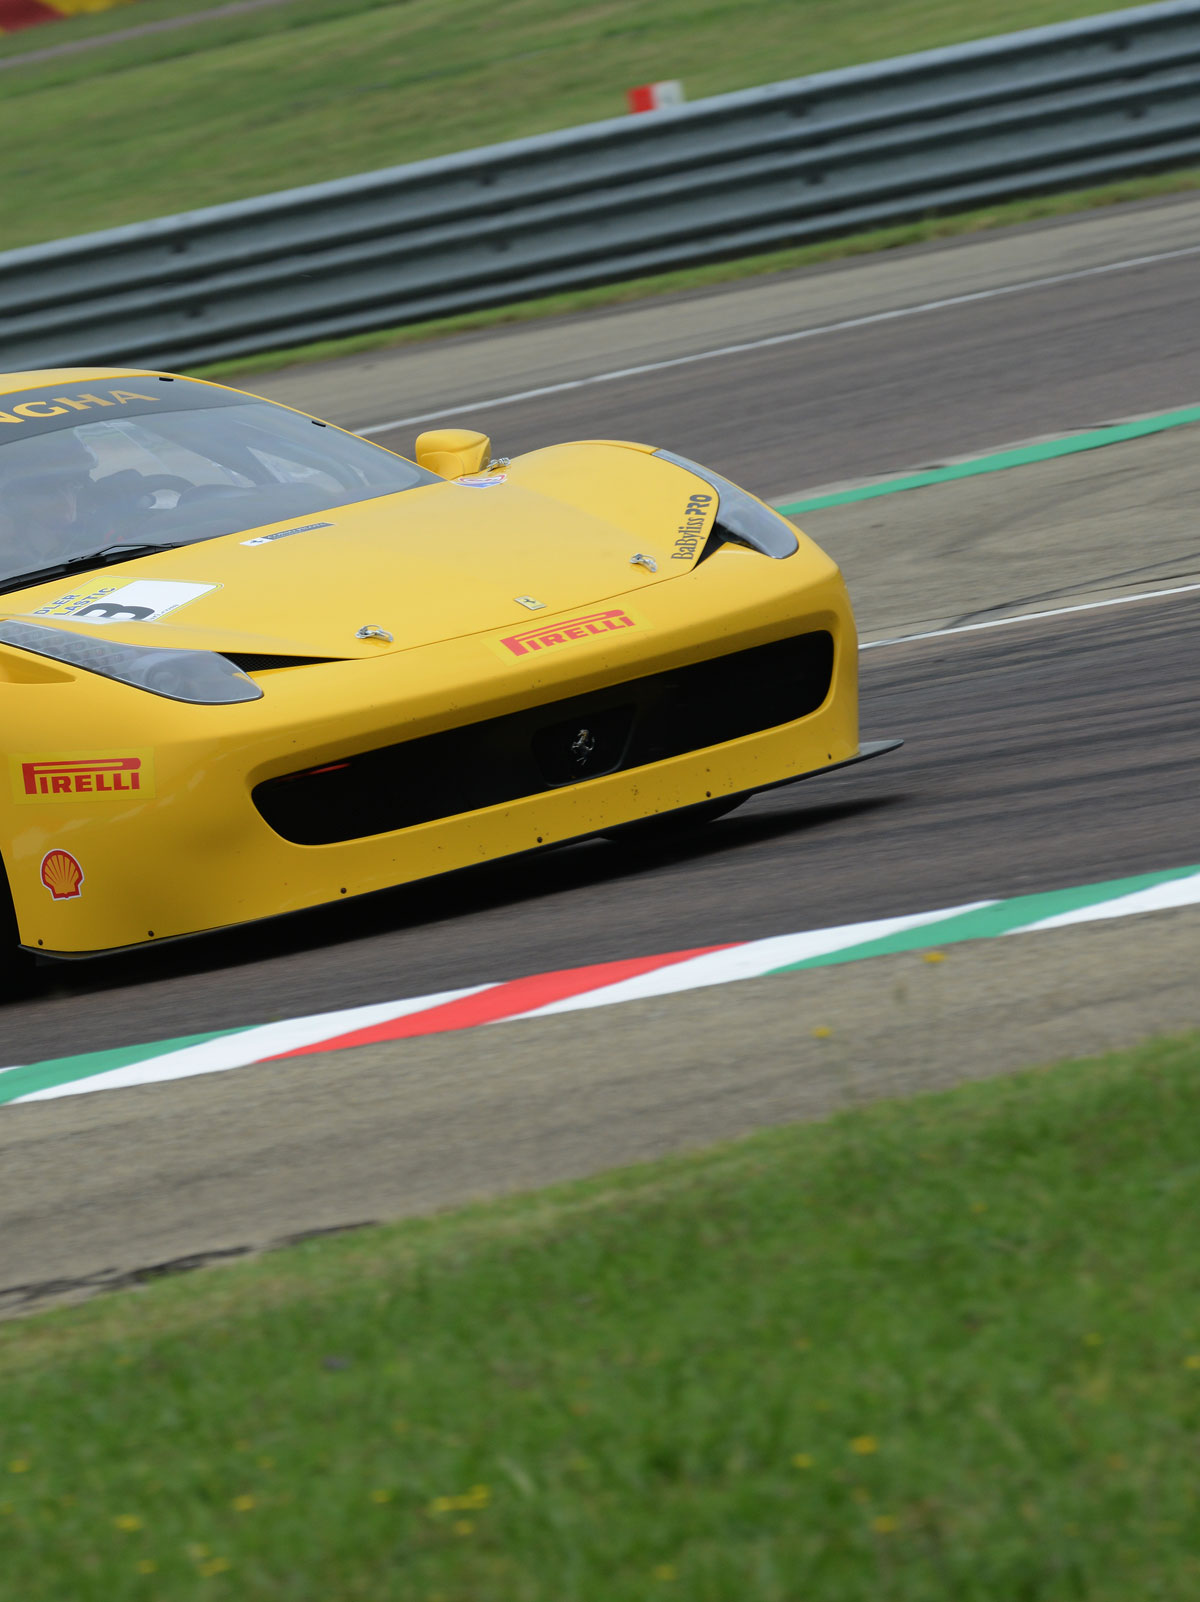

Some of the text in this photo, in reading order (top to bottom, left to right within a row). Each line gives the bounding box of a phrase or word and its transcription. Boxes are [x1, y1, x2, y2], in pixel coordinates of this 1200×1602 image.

[670, 494, 712, 560] BaByliss PRO
[33, 593, 81, 615] DLER
[53, 586, 116, 616] LASTIC
[71, 602, 155, 621] 3
[500, 609, 637, 657] PIRELLI
[22, 757, 141, 795] PIRELLI
